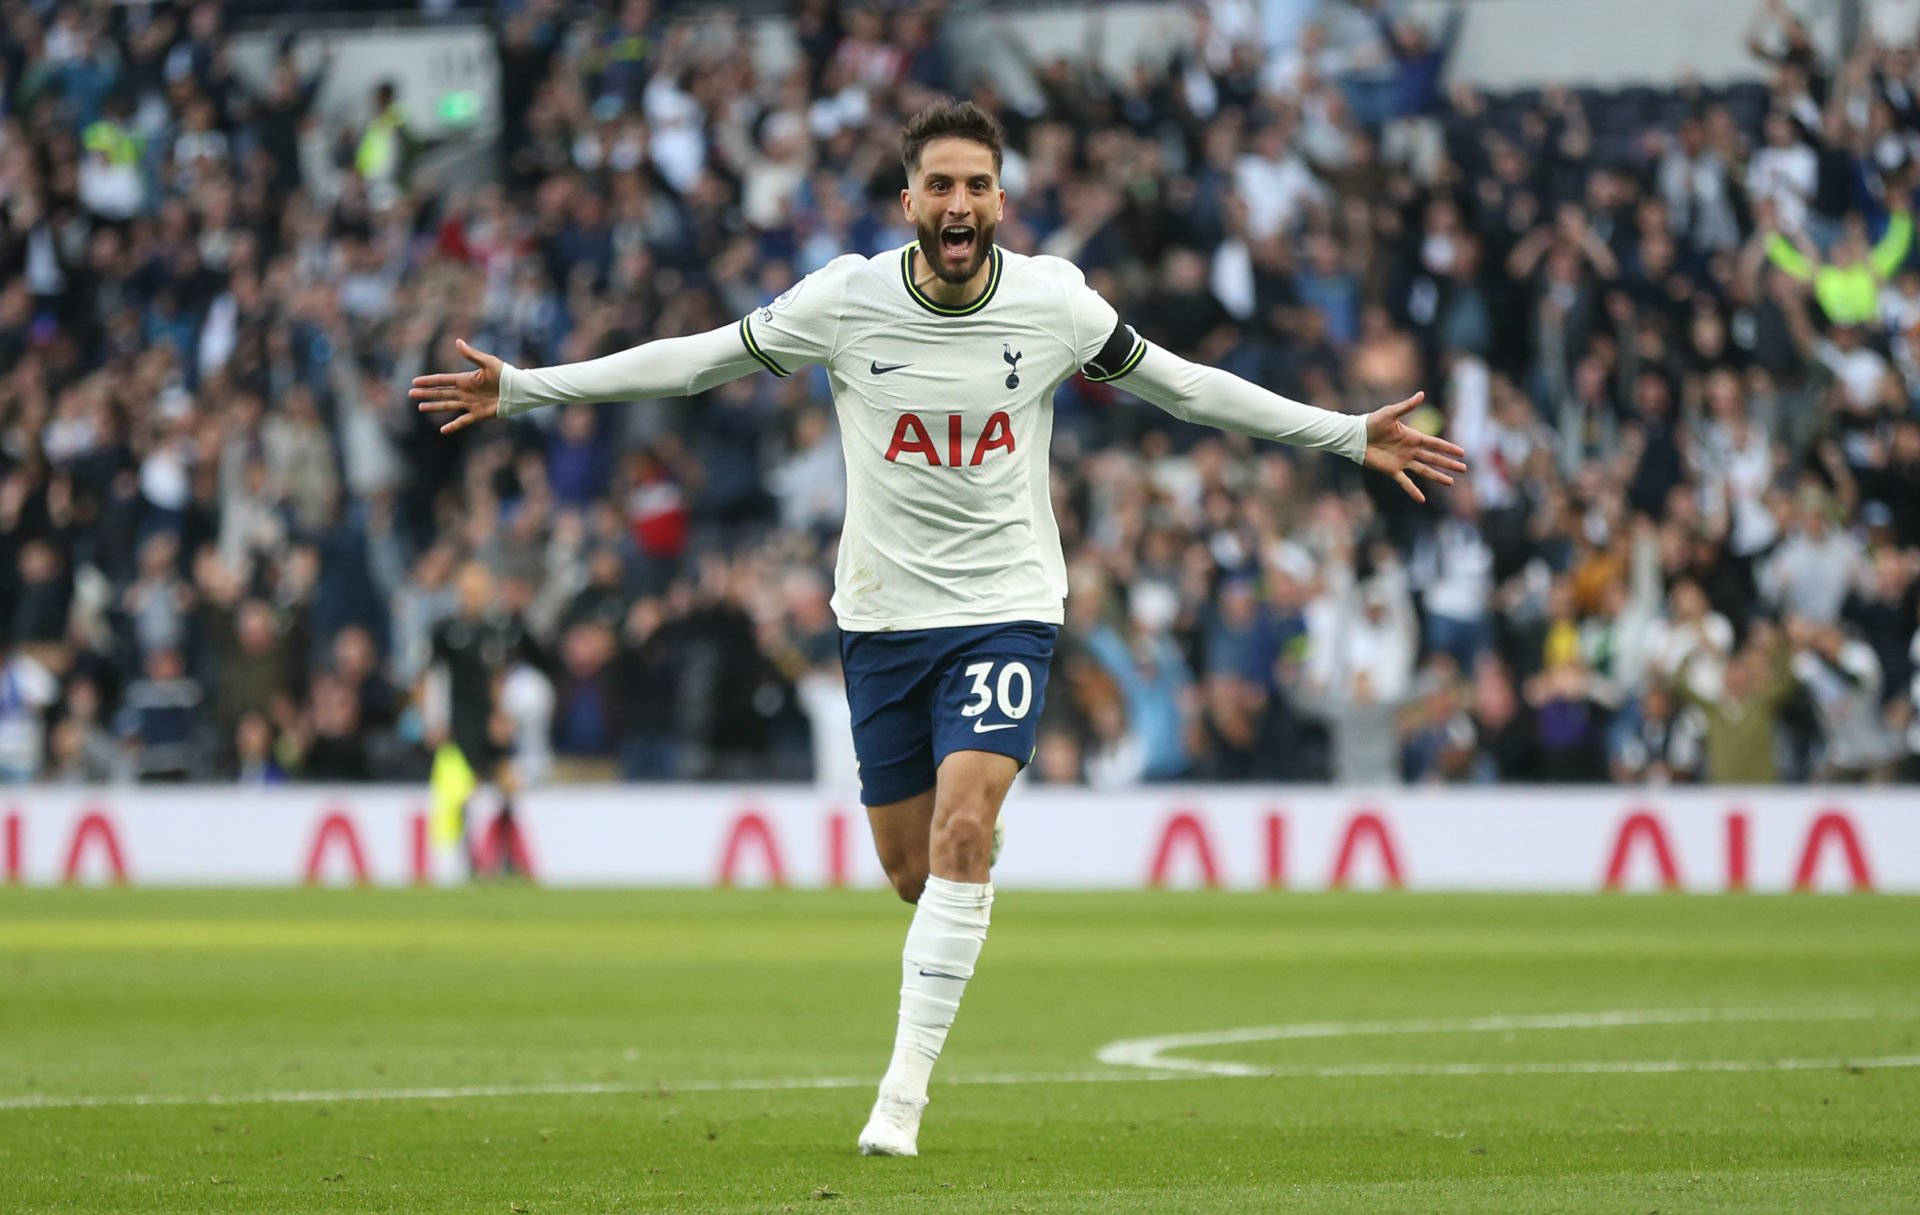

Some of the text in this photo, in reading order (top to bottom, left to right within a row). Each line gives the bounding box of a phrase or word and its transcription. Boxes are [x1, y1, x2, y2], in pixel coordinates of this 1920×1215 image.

[884, 411, 1016, 467] AIA
[961, 661, 1032, 719] 30
[718, 812, 850, 889] AI
